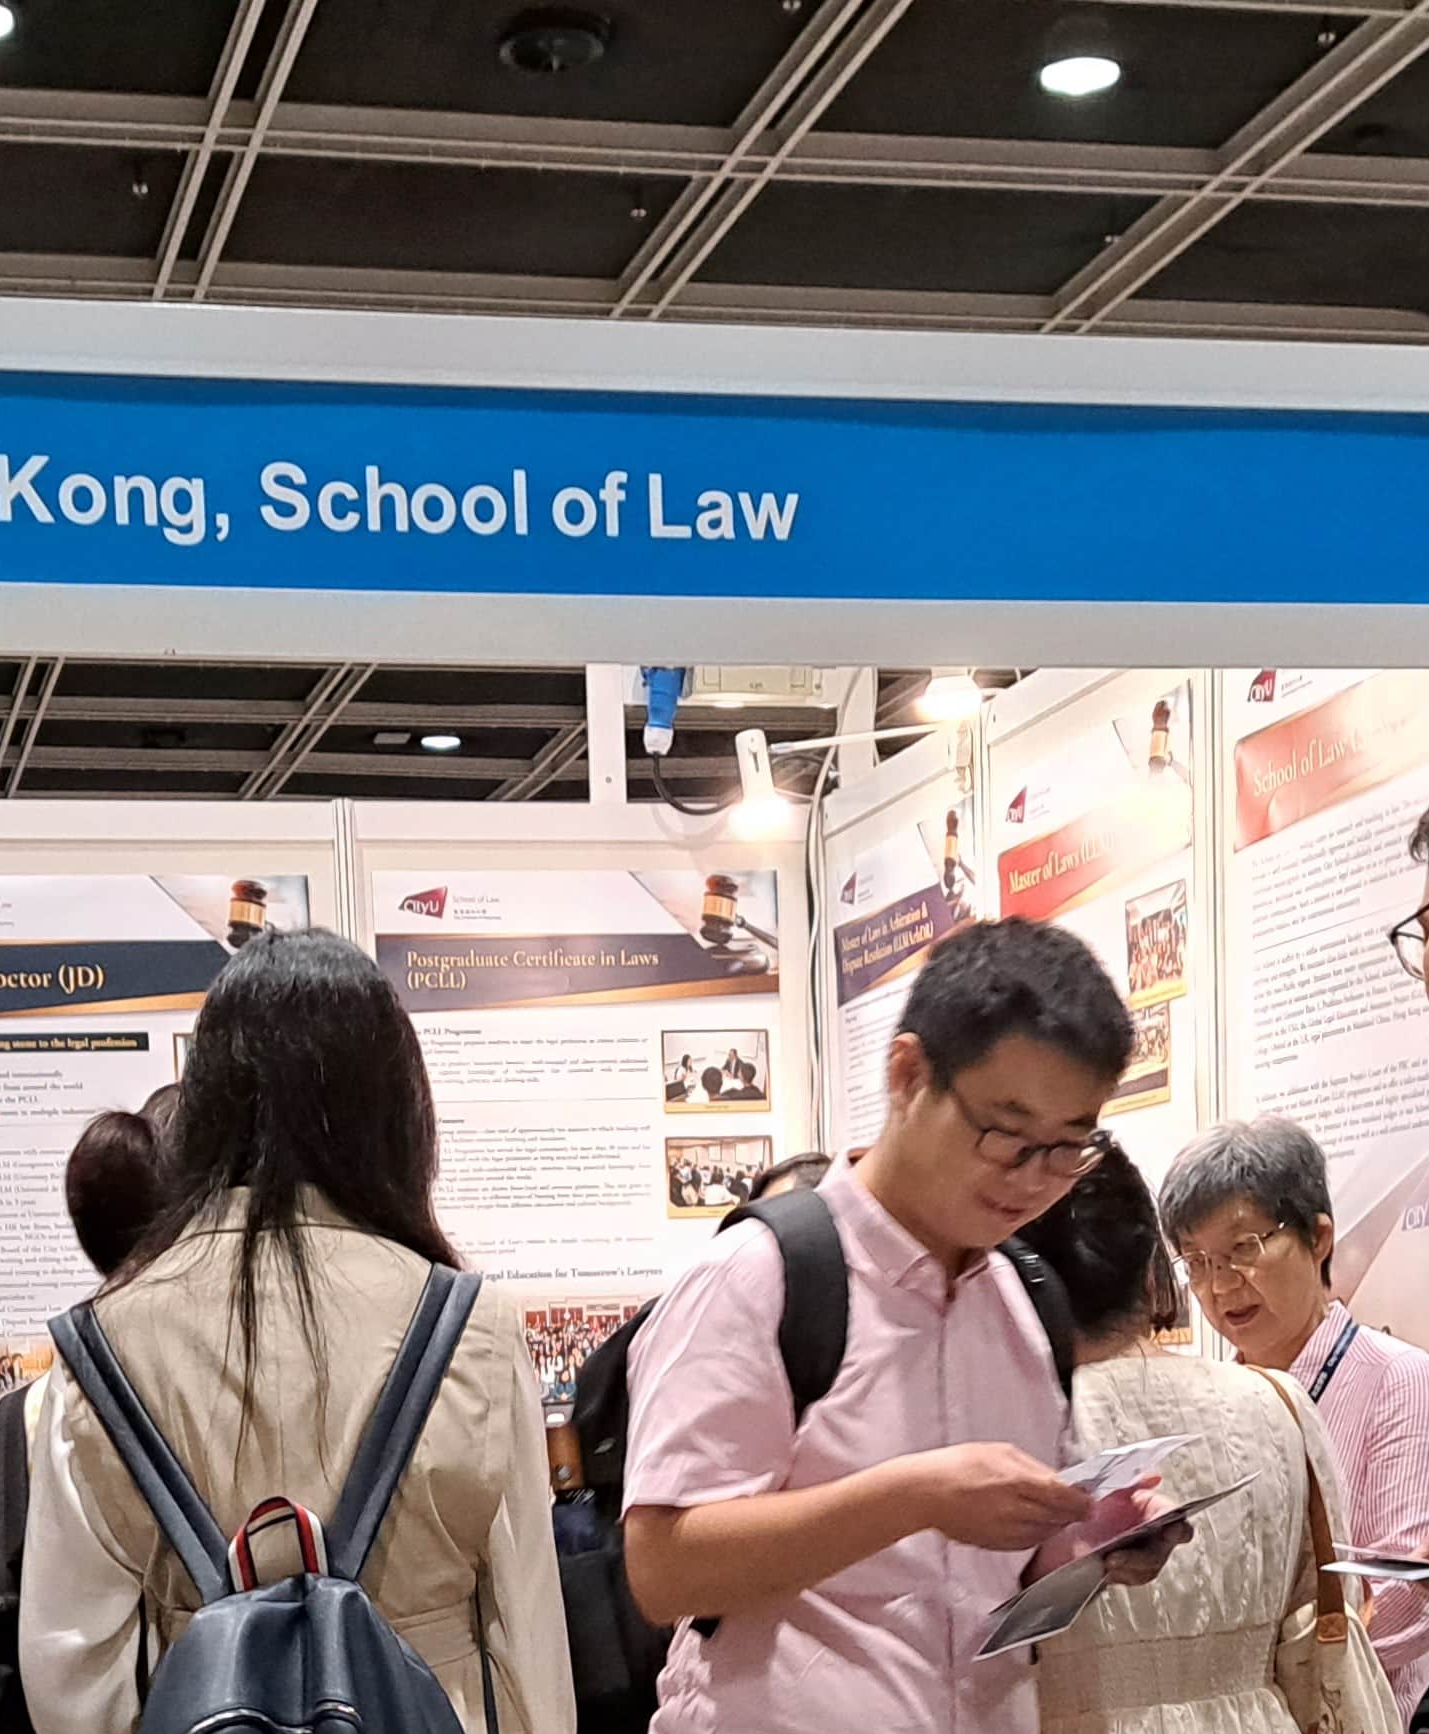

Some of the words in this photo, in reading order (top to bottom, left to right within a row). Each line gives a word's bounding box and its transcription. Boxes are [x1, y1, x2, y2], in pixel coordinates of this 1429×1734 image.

[261, 462, 527, 534] School
[553, 471, 627, 536] of
[649, 474, 798, 540] Law
[1253, 751, 1297, 797] School
[1301, 739, 1317, 776] of
[1318, 737, 1347, 769] Law
[407, 950, 509, 971] Postgraduate
[514, 949, 595, 966] Certificate
[601, 950, 615, 966] in
[621, 950, 658, 965] Laws
[59, 965, 103, 993] (JD)
[406, 970, 467, 990] (PCLL)
